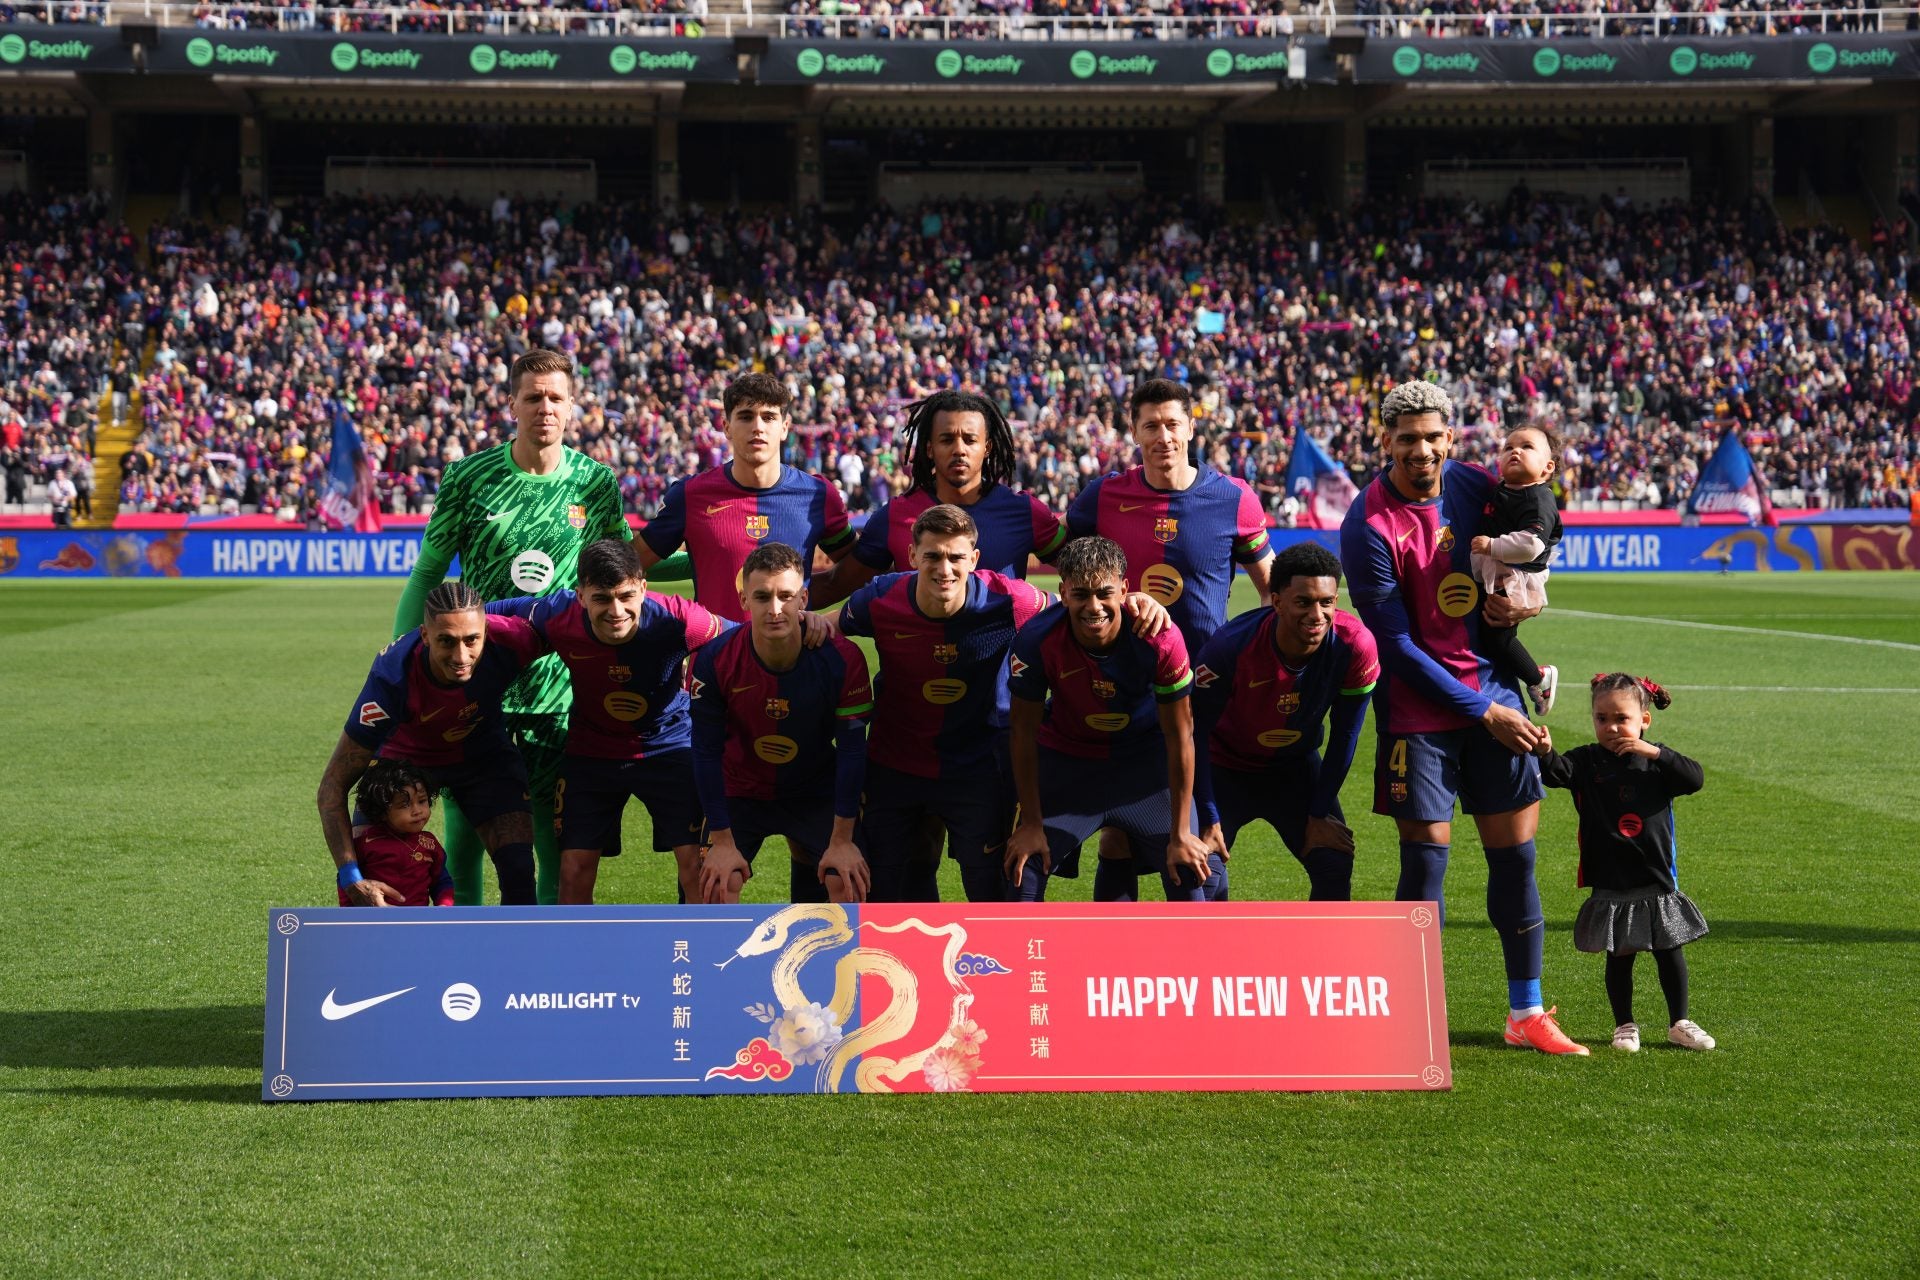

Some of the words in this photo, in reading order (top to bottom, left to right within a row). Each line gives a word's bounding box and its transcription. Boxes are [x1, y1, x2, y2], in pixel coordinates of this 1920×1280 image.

[29, 40, 91, 59] Spotify
[214, 44, 277, 64] Spotify
[360, 48, 421, 68] Spotify
[498, 49, 559, 69] Spotify
[1838, 48, 1896, 67] Spotify
[637, 50, 698, 70] Spotify
[824, 53, 885, 73] Spotify
[964, 54, 1024, 74] Spotify
[1099, 54, 1158, 74] Spotify
[1422, 53, 1479, 72] Spotify
[1562, 53, 1617, 72] Spotify
[1700, 52, 1755, 70] Spotify
[213, 540, 300, 571] HAPPY
[308, 540, 365, 571] NEW
[372, 540, 419, 571] YEA
[1595, 534, 1660, 567] YEAR
[1389, 739, 1407, 777] 4
[504, 992, 616, 1010] AMBILIGHT
[621, 994, 641, 1009] tv
[672, 940, 692, 1062] 灵蛇新生
[1027, 937, 1051, 1060] 红蓝献瑞
[1086, 976, 1198, 1018] HAPPY
[1211, 976, 1287, 1017] NEW
[1300, 975, 1391, 1017] YEAR
